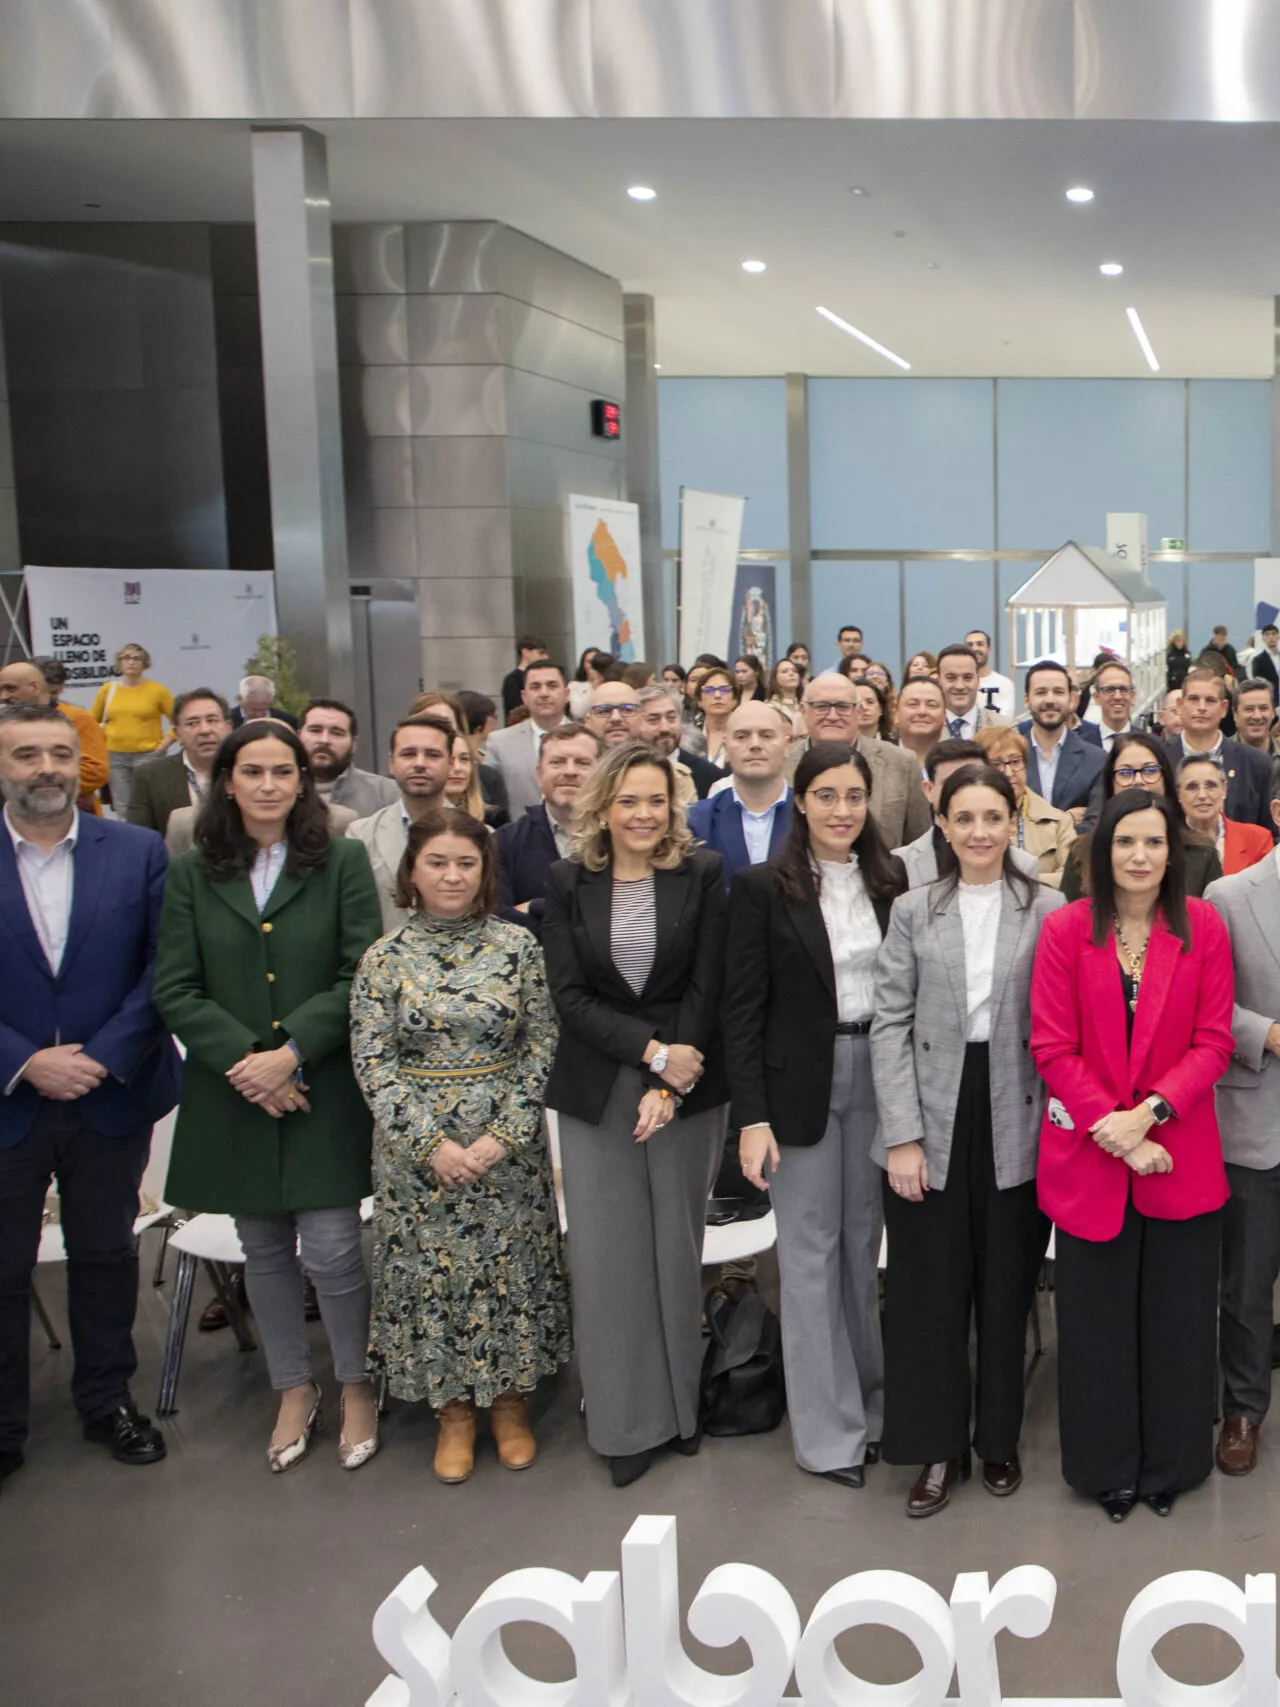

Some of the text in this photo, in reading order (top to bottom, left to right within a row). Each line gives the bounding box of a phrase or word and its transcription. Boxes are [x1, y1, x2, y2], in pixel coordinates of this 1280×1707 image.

[50, 617, 68, 630] UN
[52, 633, 100, 647] ESPACIO
[92, 649, 106, 662] DE
[365, 1515, 1057, 1707] sabor
